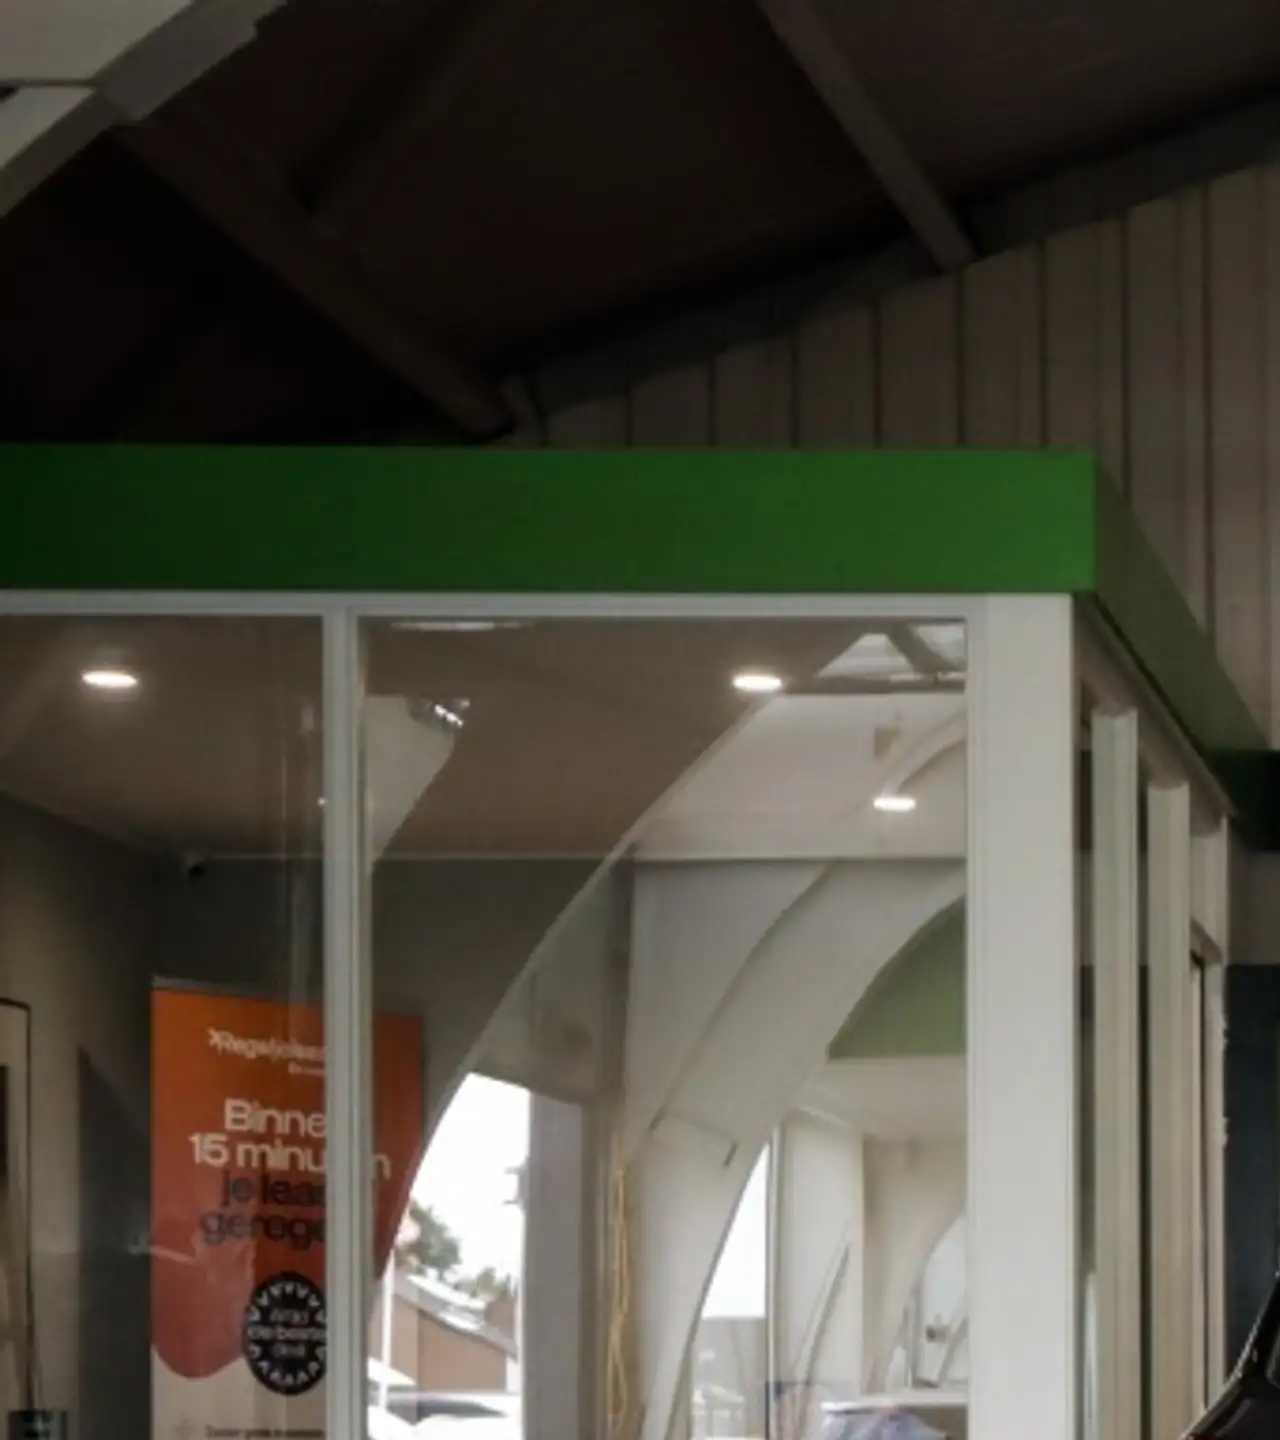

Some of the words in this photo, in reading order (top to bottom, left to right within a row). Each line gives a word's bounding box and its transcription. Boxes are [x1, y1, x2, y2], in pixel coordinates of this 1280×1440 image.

[225, 1098, 326, 1138] Binne
[188, 1132, 228, 1168] 15
[237, 1136, 392, 1180] minun
[262, 1173, 325, 1206] lea
[200, 1210, 325, 1251] gereg
